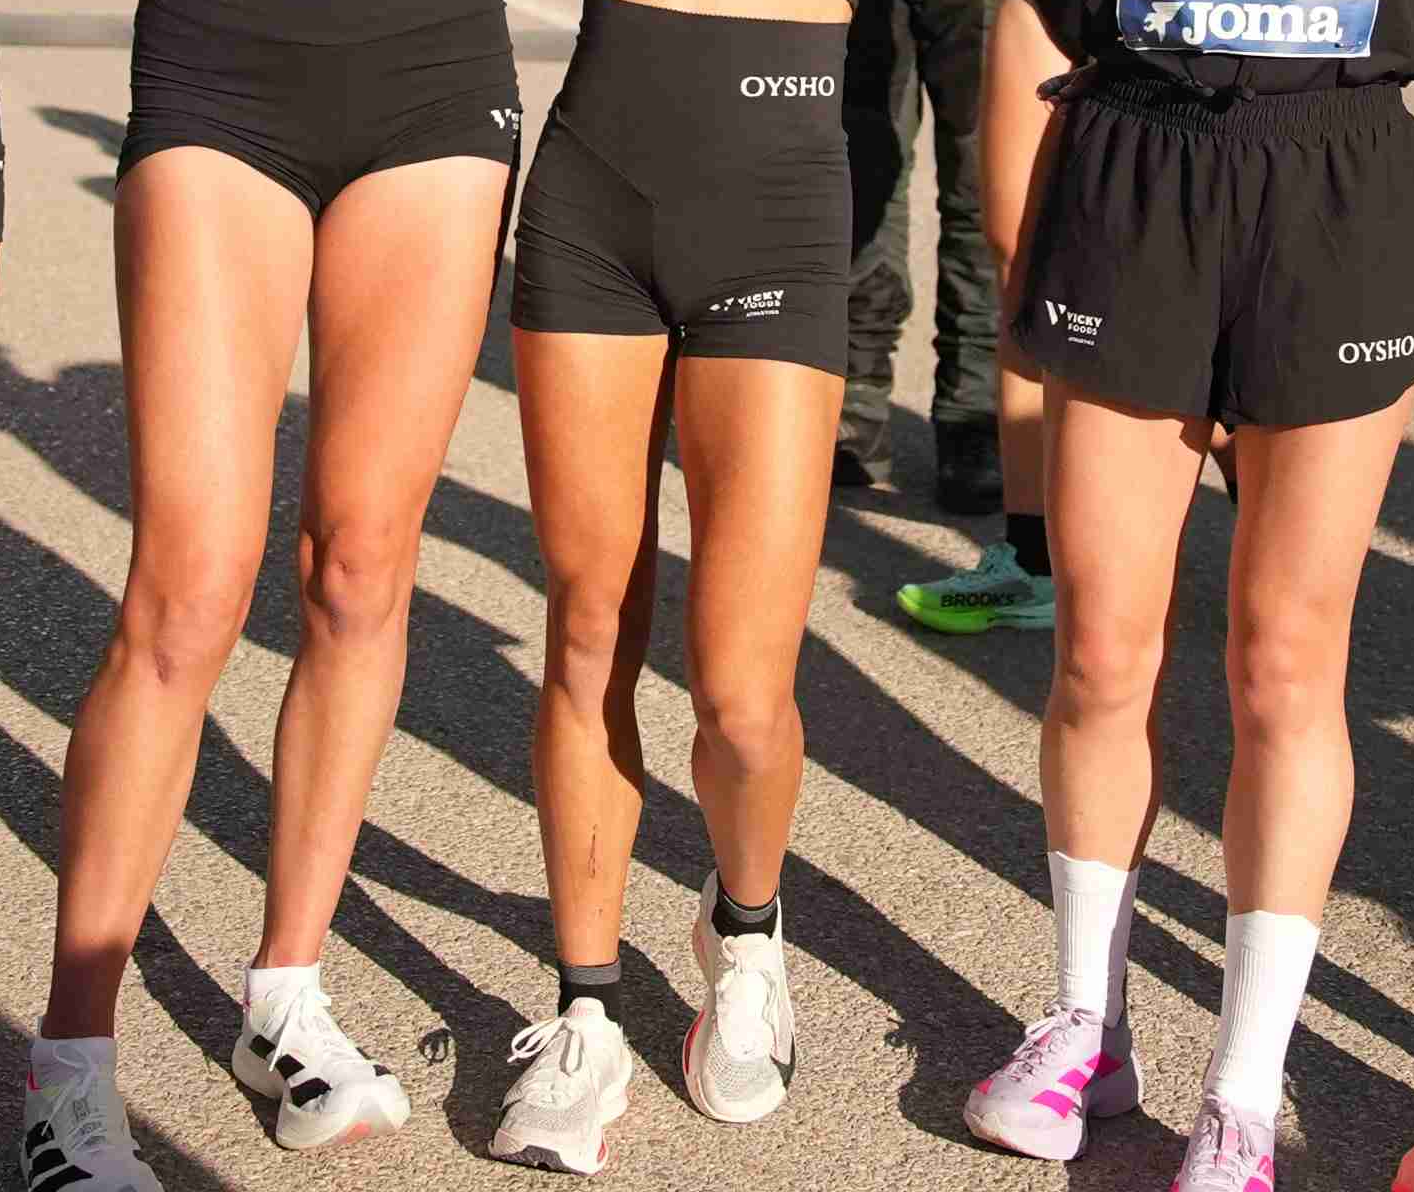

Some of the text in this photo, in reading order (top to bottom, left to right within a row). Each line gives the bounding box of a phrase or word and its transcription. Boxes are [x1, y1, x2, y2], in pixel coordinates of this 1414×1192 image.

[739, 75, 836, 98] OYSHO
[737, 289, 785, 305] VICKY
[1067, 311, 1104, 328] VICKY
[940, 593, 1016, 609] BROOKS
